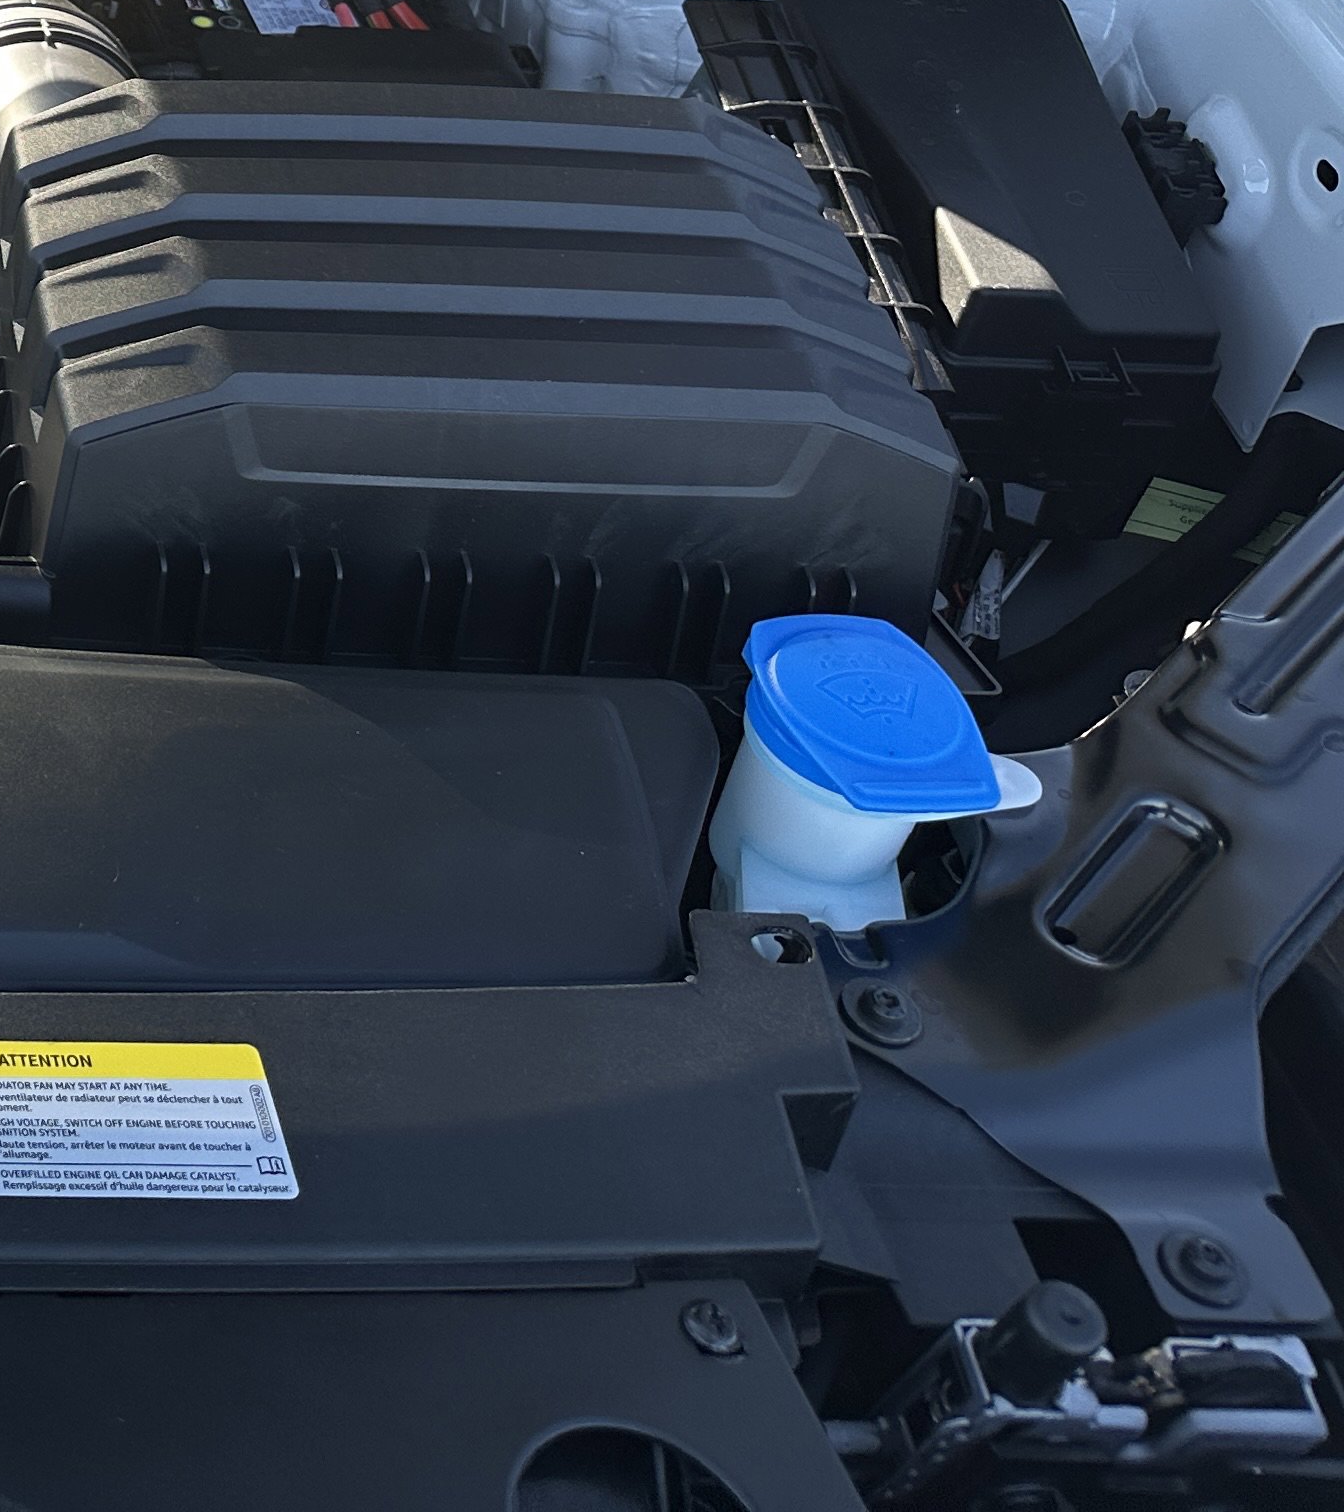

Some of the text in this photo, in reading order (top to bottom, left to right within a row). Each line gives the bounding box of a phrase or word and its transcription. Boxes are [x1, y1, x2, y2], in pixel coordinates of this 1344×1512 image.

[34, 1081, 53, 1090] FAN
[56, 1082, 76, 1090] MAY
[79, 1082, 108, 1090] START
[110, 1082, 121, 1090] AT
[124, 1082, 143, 1091] ANY
[0, 1093, 52, 1102] ventilateur
[55, 1094, 68, 1102] de
[70, 1094, 116, 1102] radiateur
[118, 1095, 140, 1104] peut
[144, 1096, 154, 1104] se
[157, 1094, 211, 1104] déclencher
[213, 1095, 220, 1104] à
[221, 1096, 243, 1104] tout
[65, 1119, 102, 1128] SWITCH
[104, 1120, 124, 1128] OFF
[126, 1120, 163, 1128] ENGINE
[165, 1120, 203, 1129] BEFORE
[204, 1120, 256, 1130] TOUCHING
[70, 1140, 106, 1150] arrêter
[108, 1141, 117, 1150] le
[120, 1142, 156, 1150] moteur
[158, 1142, 187, 1151] avant
[189, 1142, 202, 1151] de
[204, 1142, 244, 1152] toucher
[245, 1143, 252, 1151] à
[0, 1170, 61, 1179] OVERFILLED
[64, 1170, 101, 1179] ENGINE
[104, 1170, 120, 1180] OIL
[122, 1171, 142, 1180] CAN
[146, 1172, 188, 1180] DAMAGE
[2, 1181, 66, 1192] Remplissage
[68, 1181, 108, 1190] excessif
[146, 1182, 199, 1194] dangereux
[202, 1184, 224, 1194] pour
[226, 1183, 236, 1192] le
